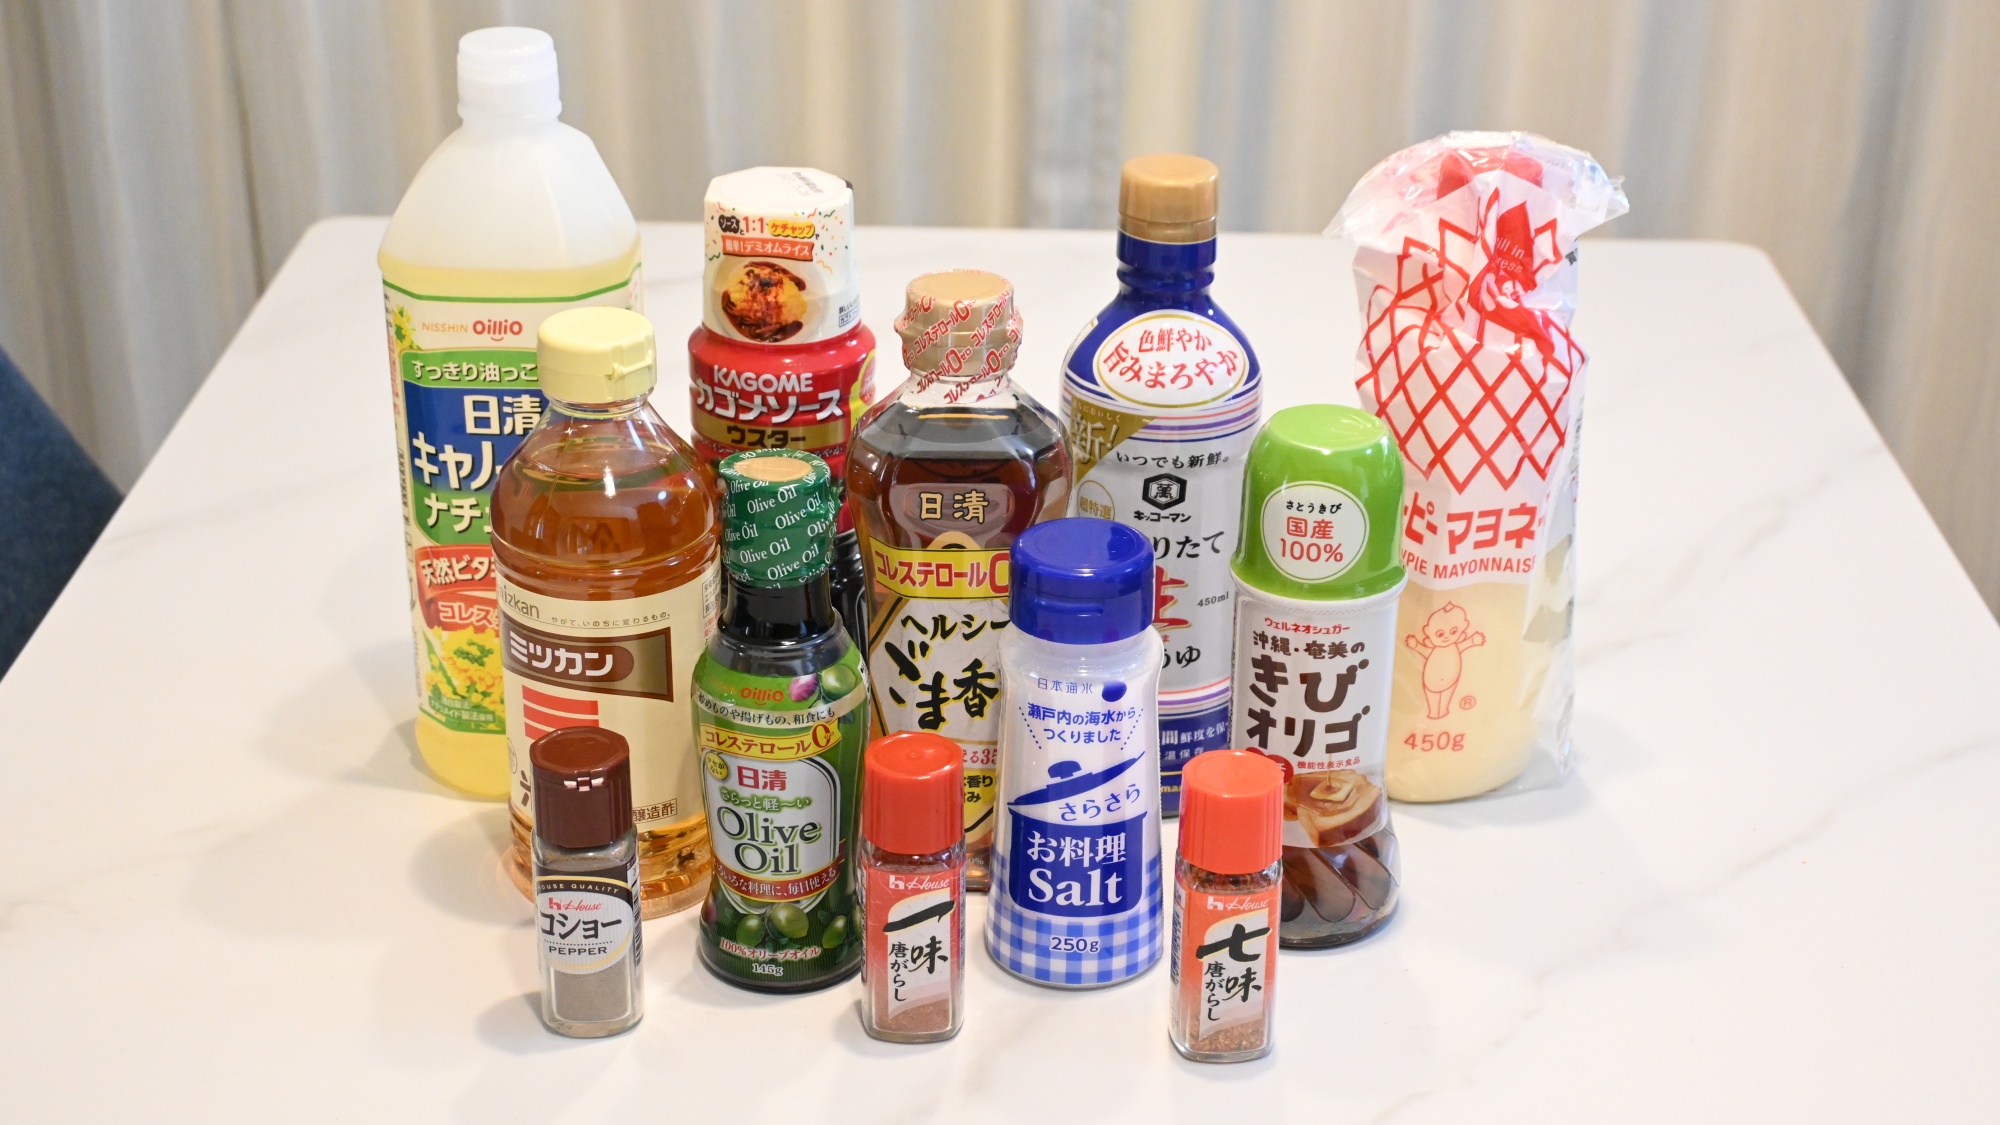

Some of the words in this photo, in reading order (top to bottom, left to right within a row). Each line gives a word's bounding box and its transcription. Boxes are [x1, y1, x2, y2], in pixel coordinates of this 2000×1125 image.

[725, 239, 811, 257] 簡単!デミオムライス
[422, 322, 468, 333] NISSHIN
[1138, 327, 1213, 353] 色鮮やか
[412, 359, 538, 382] すっきり油っこ
[1102, 340, 1239, 390] 旨みまろやか
[713, 364, 813, 393] KAGOME
[696, 378, 843, 424] カゴメソース
[463, 394, 542, 436] 日清
[727, 425, 806, 448] ウスター
[412, 432, 500, 491] キャノ
[730, 480, 750, 494] Olive
[747, 497, 776, 514] Olive
[777, 485, 798, 503] Oil
[425, 493, 490, 533] ナチ
[775, 509, 807, 529] Olive
[807, 492, 821, 511] Oil
[920, 490, 989, 524] 日清
[1134, 510, 1191, 523] キッコーマン
[1286, 500, 1342, 514] さとうきび
[725, 528, 740, 542] Olive
[741, 522, 759, 539] Oil
[1287, 516, 1334, 539] 国産
[1403, 491, 1438, 546] ピー
[1447, 502, 1545, 555] マヨネ
[740, 550, 768, 563] Olive
[769, 537, 791, 555] Oil
[767, 561, 800, 580] Olive
[802, 544, 819, 563] Oil
[1280, 538, 1344, 563] 100%
[419, 555, 496, 587] 天然ビタ
[875, 550, 1010, 594] コレステロール0
[1198, 591, 1229, 607] 450ml
[552, 611, 671, 627] やがて、いのちに変わるもの。
[901, 613, 1011, 641] ヘルシー
[1264, 617, 1350, 635] ウェルネオシュガー
[509, 630, 613, 677] ミツカン
[1253, 630, 1366, 660] 沖縄・奄美の
[1249, 654, 1370, 713] きび
[698, 693, 835, 726] 炒めものや揚げもの、和食にも
[1027, 702, 1136, 726] 瀬戸内の海水から
[1043, 728, 1121, 744] つくりました
[1161, 721, 1228, 745] 間鮮度を保
[1246, 705, 1371, 758] オリゴ
[1404, 731, 1466, 752] 450g
[1297, 756, 1361, 769] 機能性表示食品
[737, 765, 787, 791] 日清
[964, 774, 994, 788] 香り
[964, 791, 982, 803] み
[1058, 783, 1141, 822] さらさら
[717, 806, 819, 844] Olive
[735, 842, 799, 874] Oil
[1027, 830, 1126, 868] お料理
[571, 883, 619, 894] QUALITY
[906, 876, 950, 891] House
[1028, 868, 1123, 907] Salt
[563, 900, 602, 911] House
[1225, 896, 1269, 911] House
[540, 911, 622, 940] コショー
[549, 945, 608, 956] PEPPER
[1050, 936, 1100, 952] 250g
[752, 963, 784, 976] 145g
[888, 941, 910, 1001] 唐がらし
[1196, 923, 1271, 1002] 七味
[1204, 961, 1226, 1022] 唐がらし
